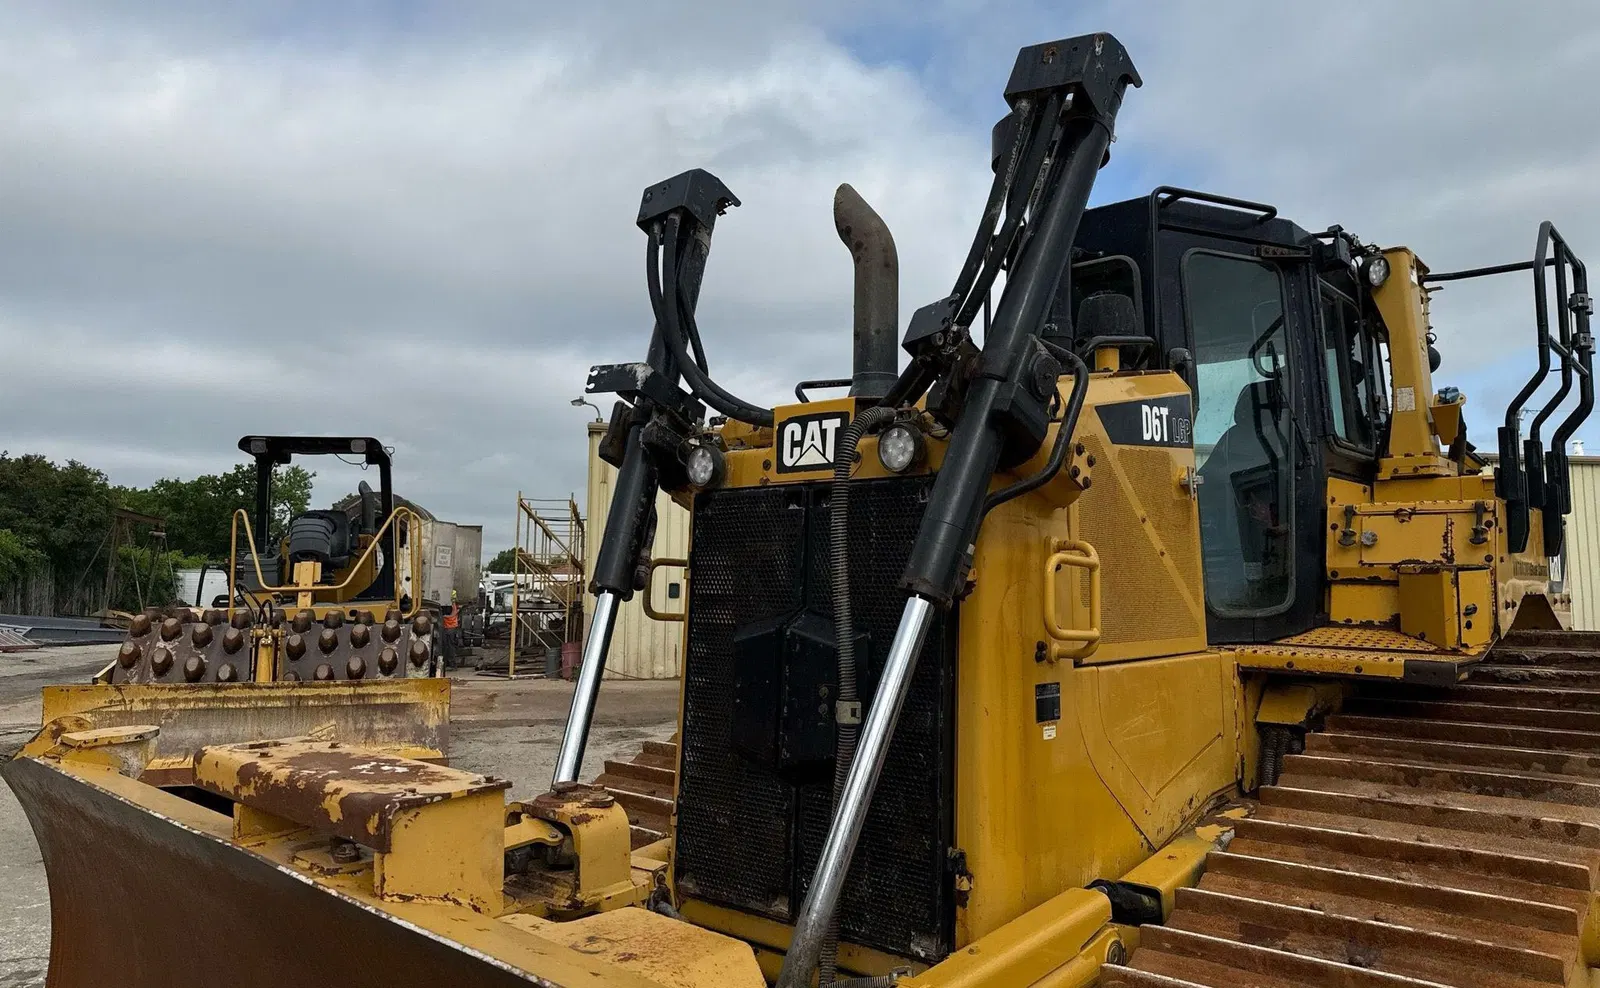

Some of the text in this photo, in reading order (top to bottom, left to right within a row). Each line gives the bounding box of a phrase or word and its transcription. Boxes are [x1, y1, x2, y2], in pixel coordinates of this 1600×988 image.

[782, 418, 841, 467] CAT
[1141, 404, 1191, 443] D6T LGP
